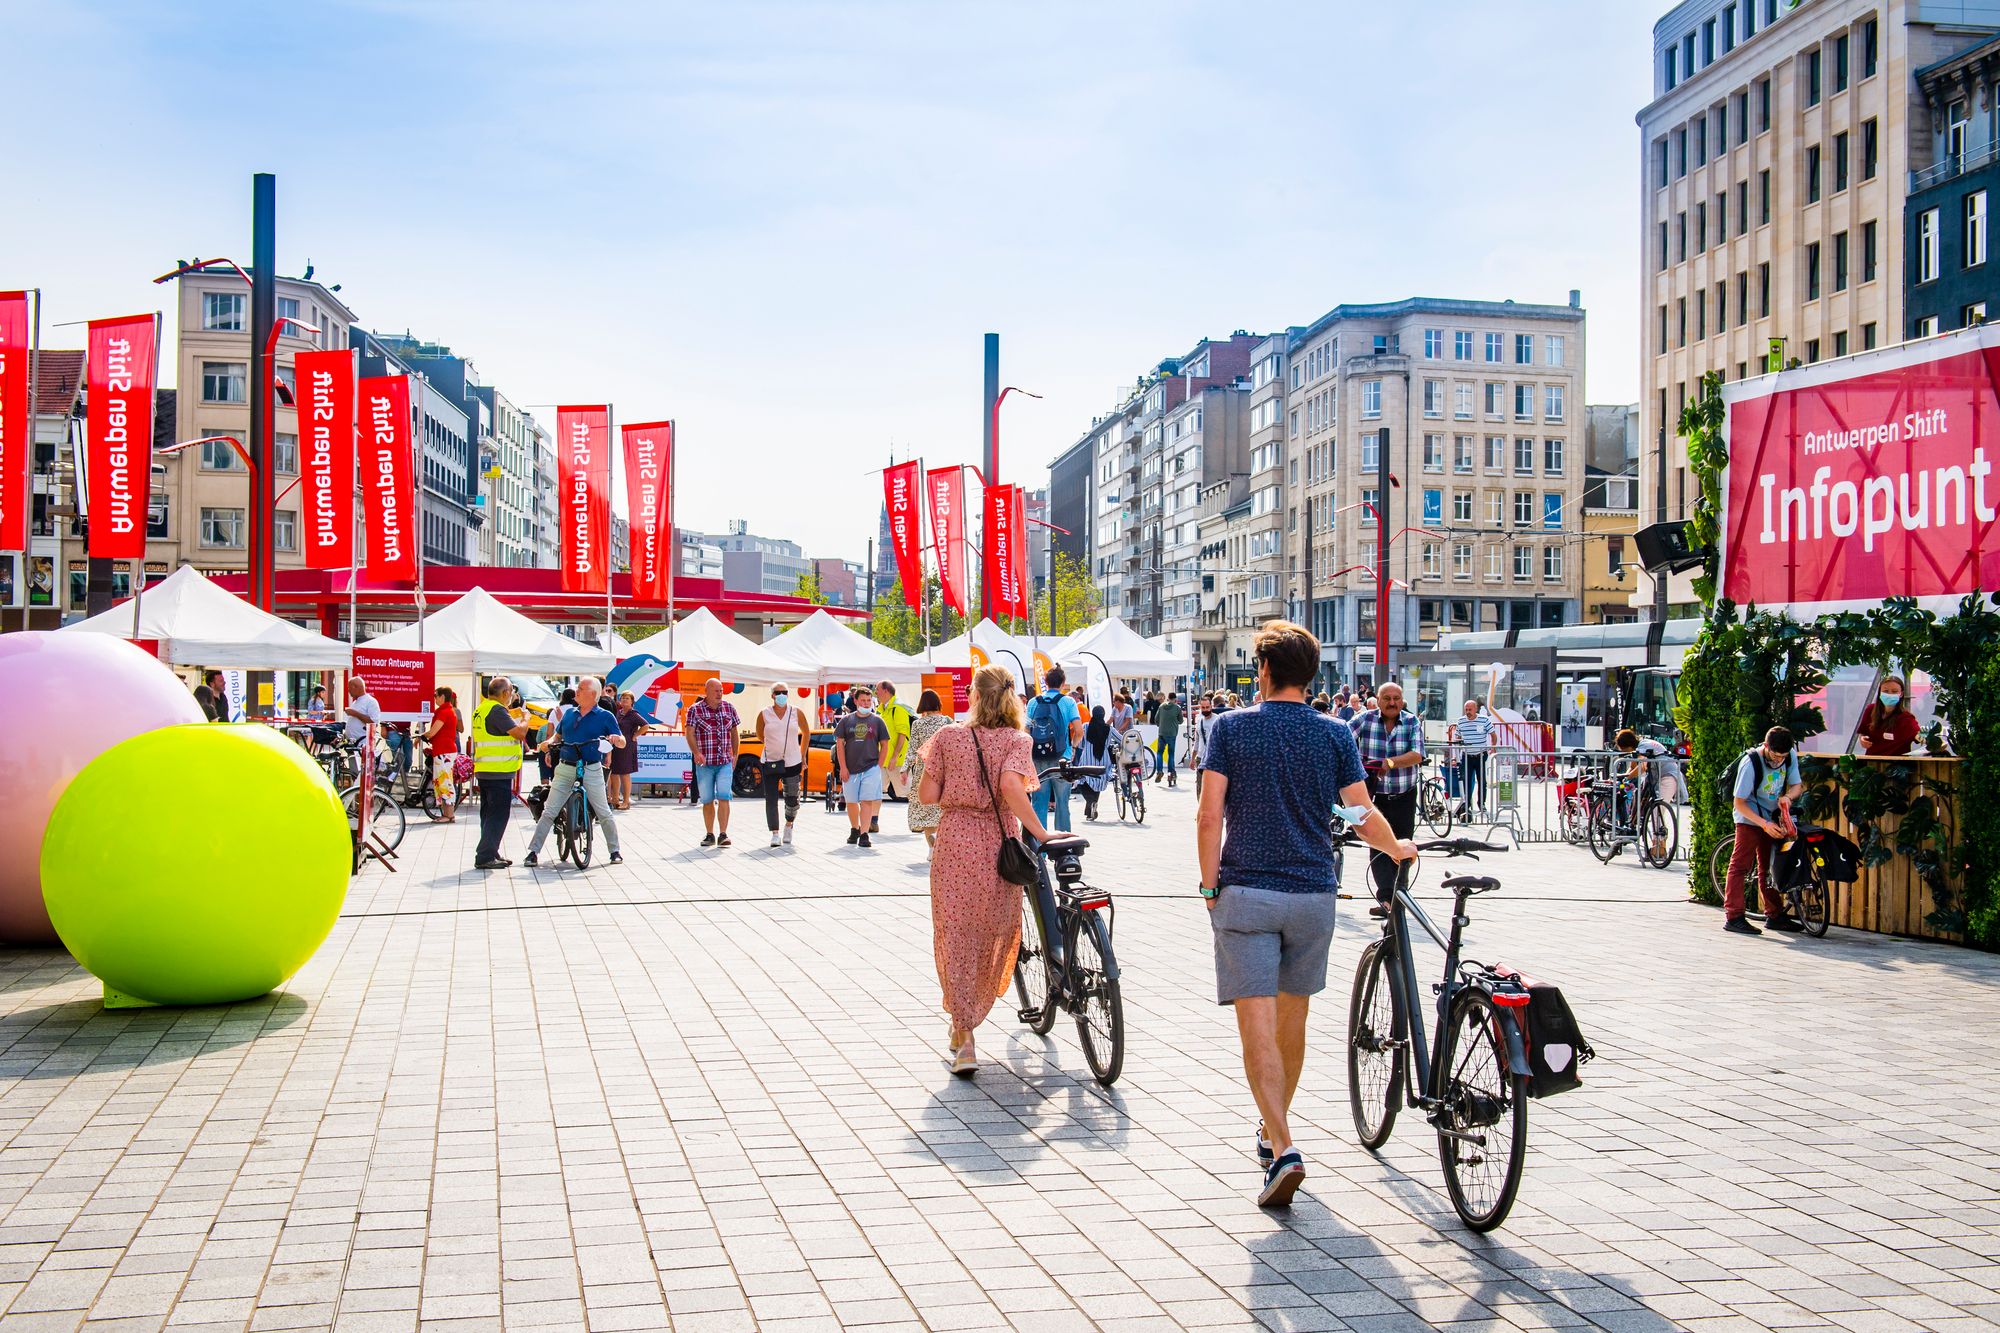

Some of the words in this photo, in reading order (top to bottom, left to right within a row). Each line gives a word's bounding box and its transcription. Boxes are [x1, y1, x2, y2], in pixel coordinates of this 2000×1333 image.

[1804, 420, 1899, 456] Antwerpen
[1904, 408, 1948, 440] Shift
[1759, 447, 1995, 552] Infopunt
[356, 655, 371, 666] Slim
[372, 659, 387, 667] naar
[388, 657, 424, 670] Antwerpen
